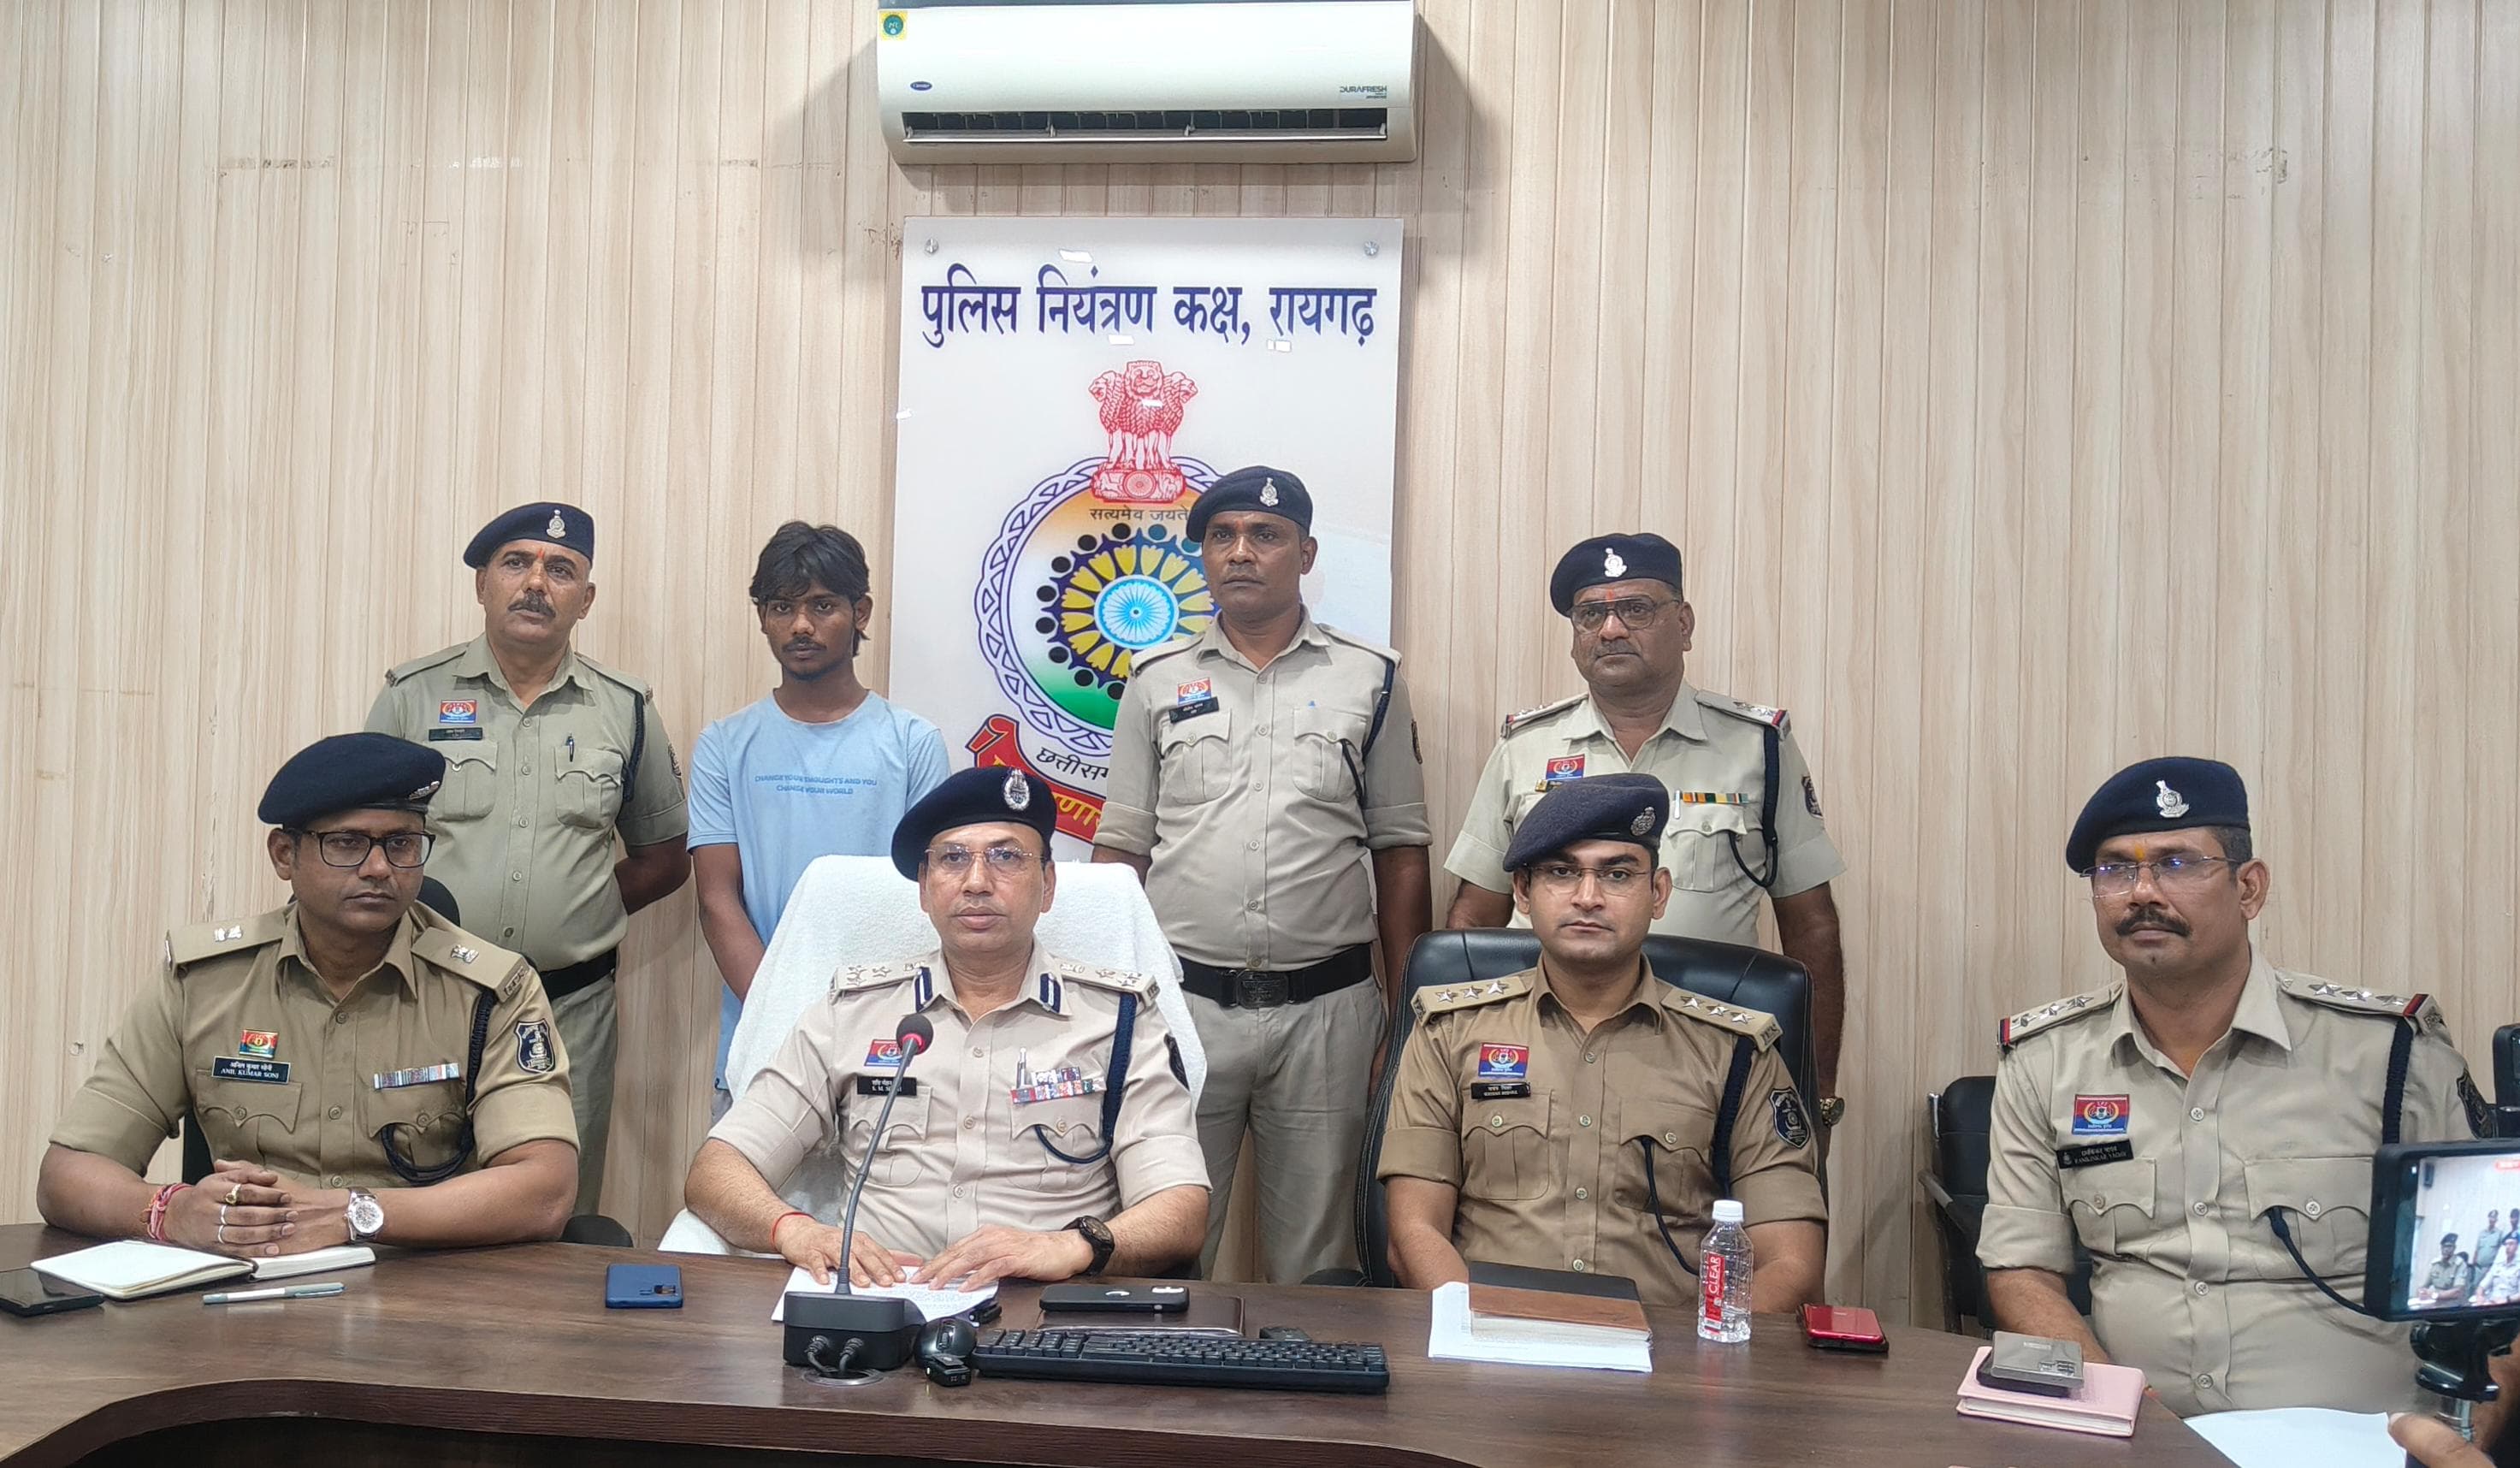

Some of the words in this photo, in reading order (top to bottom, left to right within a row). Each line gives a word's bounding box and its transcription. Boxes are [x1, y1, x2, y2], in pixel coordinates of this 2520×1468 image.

[921, 263, 1021, 348] पुलिस
[1036, 263, 1157, 334] नियंत्रण
[1173, 287, 1251, 346] कक्ष,
[1269, 287, 1377, 347] रायगढ़
[1089, 504, 1145, 521] सत्यमेव
[1150, 505, 1190, 522] जयते
[1707, 1255, 1722, 1294] CLEAR
